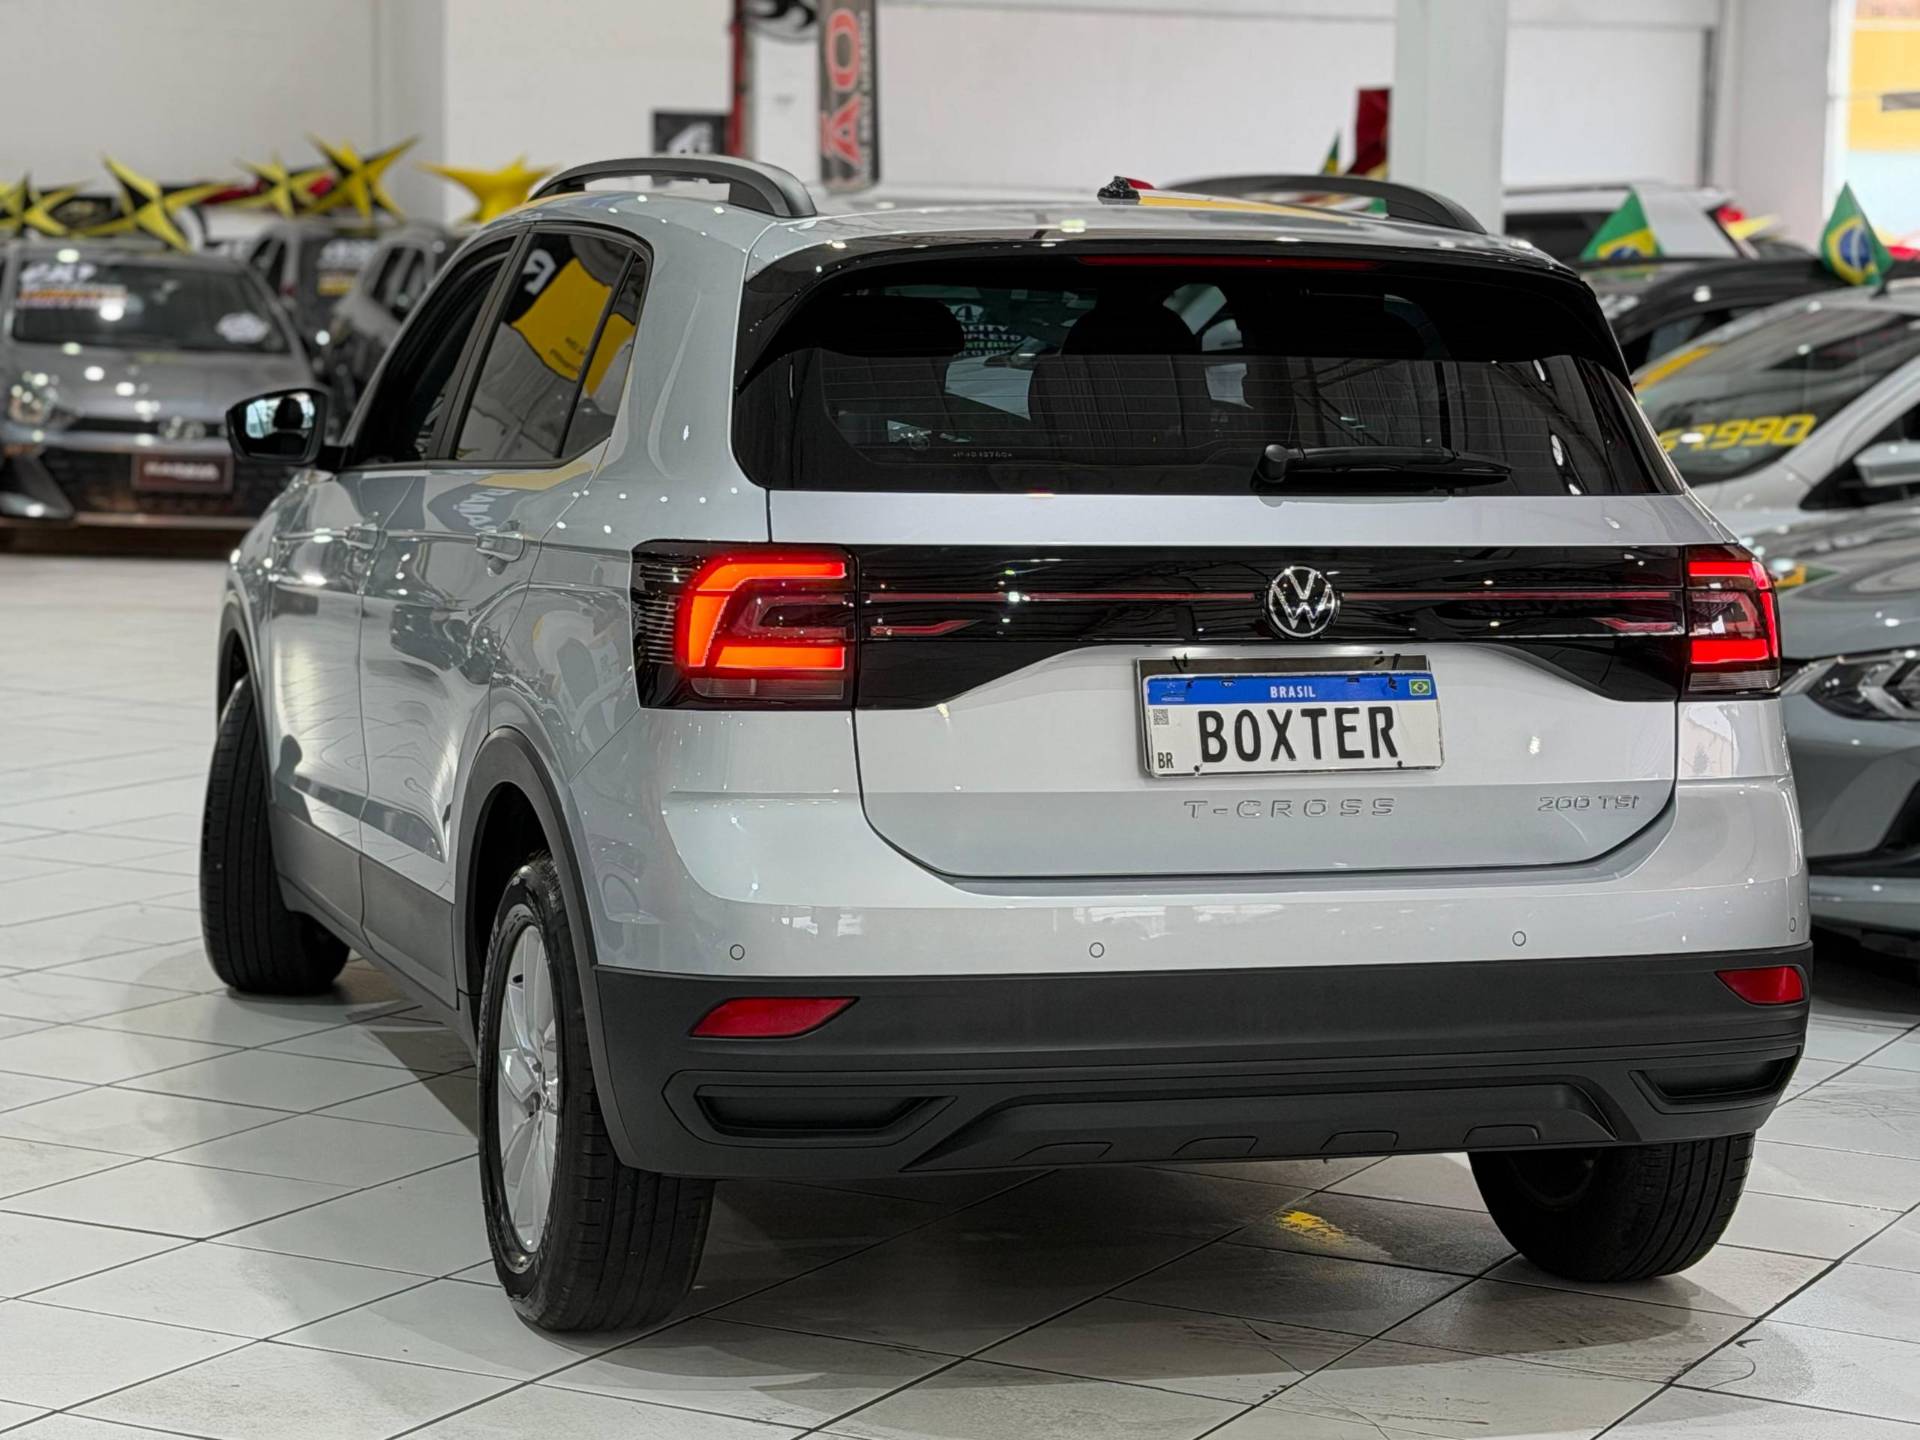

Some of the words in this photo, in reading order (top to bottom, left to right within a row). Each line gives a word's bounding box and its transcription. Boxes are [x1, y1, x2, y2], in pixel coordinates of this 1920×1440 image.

[1270, 686, 1316, 698] BRASIL
[1198, 706, 1398, 763] BOXTER
[1157, 752, 1174, 769] BR
[1183, 798, 1395, 819] T-CROSS
[1537, 796, 1591, 811] 200
